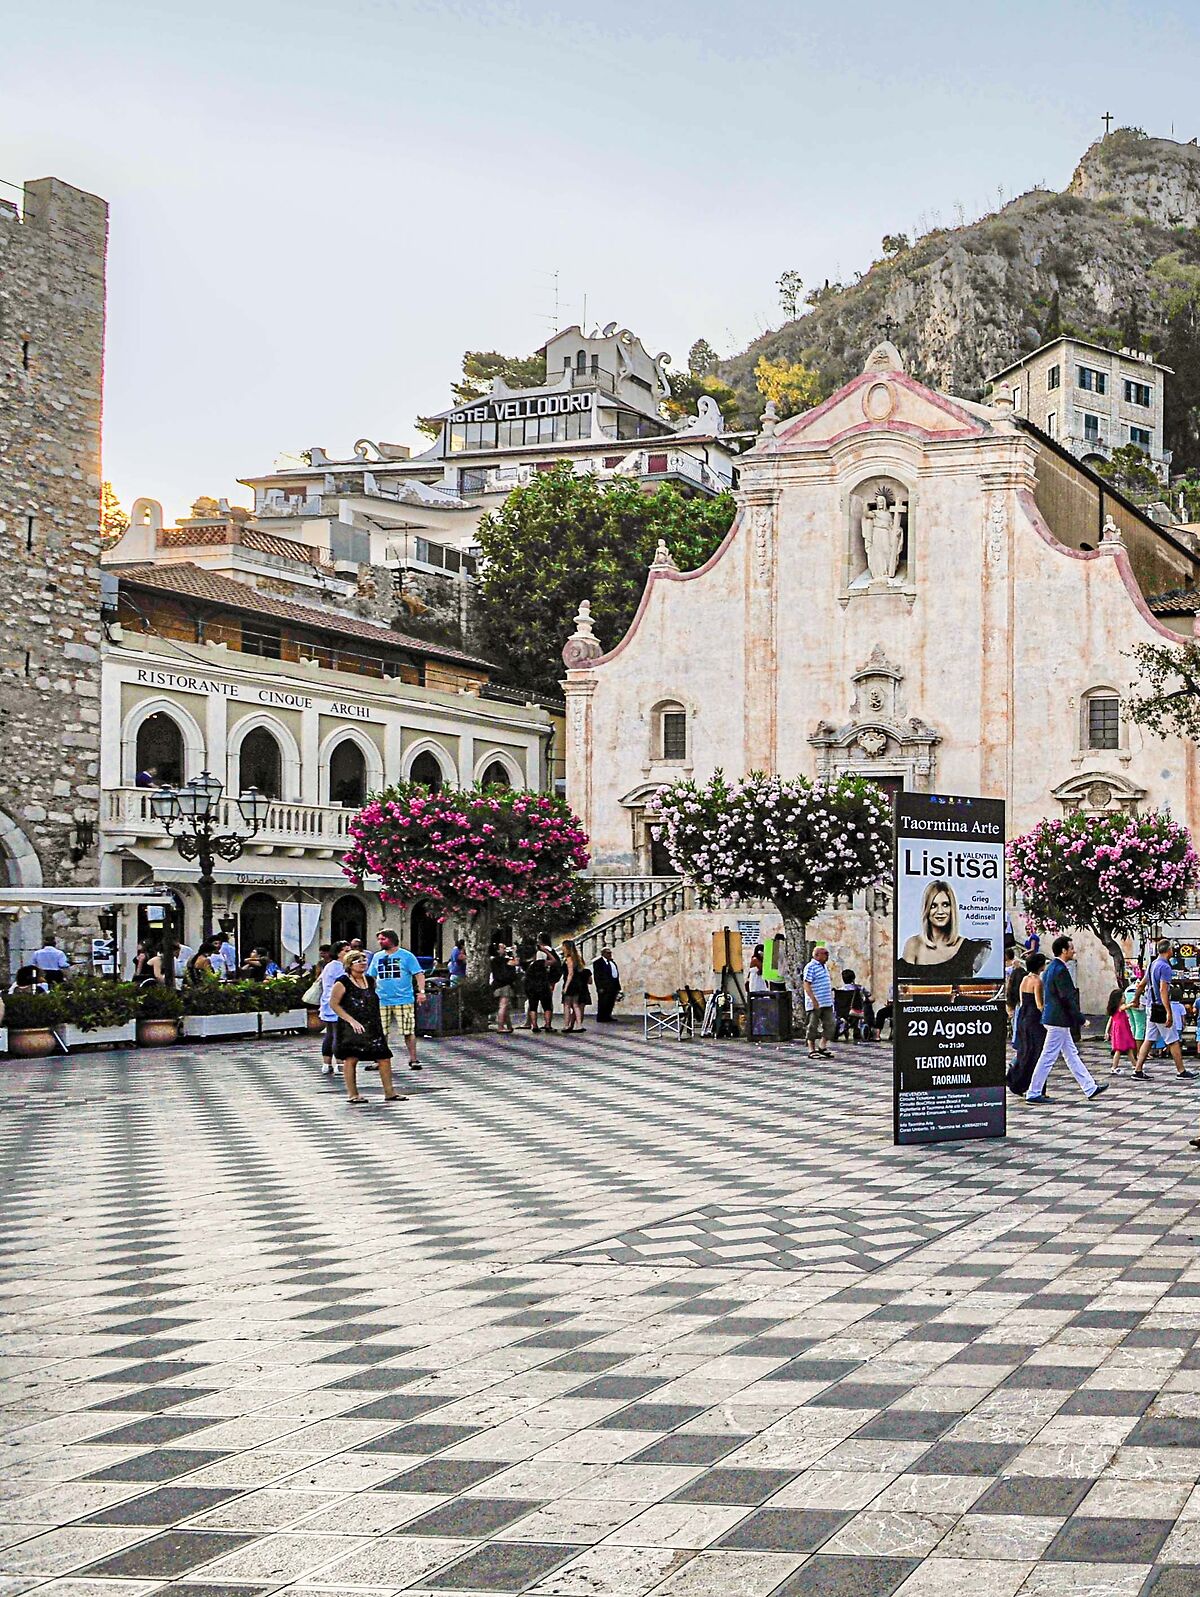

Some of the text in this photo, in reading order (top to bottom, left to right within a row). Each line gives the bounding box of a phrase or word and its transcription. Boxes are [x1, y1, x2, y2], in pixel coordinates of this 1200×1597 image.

[448, 406, 494, 424] HOTEL
[137, 669, 371, 718] RISTORANTE CINQUE ARCHI
[900, 815, 1000, 835] Taormina Arte
[962, 852, 998, 860] VALENTINA
[905, 849, 998, 879] Lisitsa
[971, 895, 989, 904] Grieg
[958, 904, 1002, 912] Rachmaninov
[965, 913, 996, 921] Addinsell
[908, 1019, 992, 1039] 29 Agosto
[915, 1054, 987, 1069] TEATRO ANTICO
[932, 1074, 971, 1085] TAORMINA
